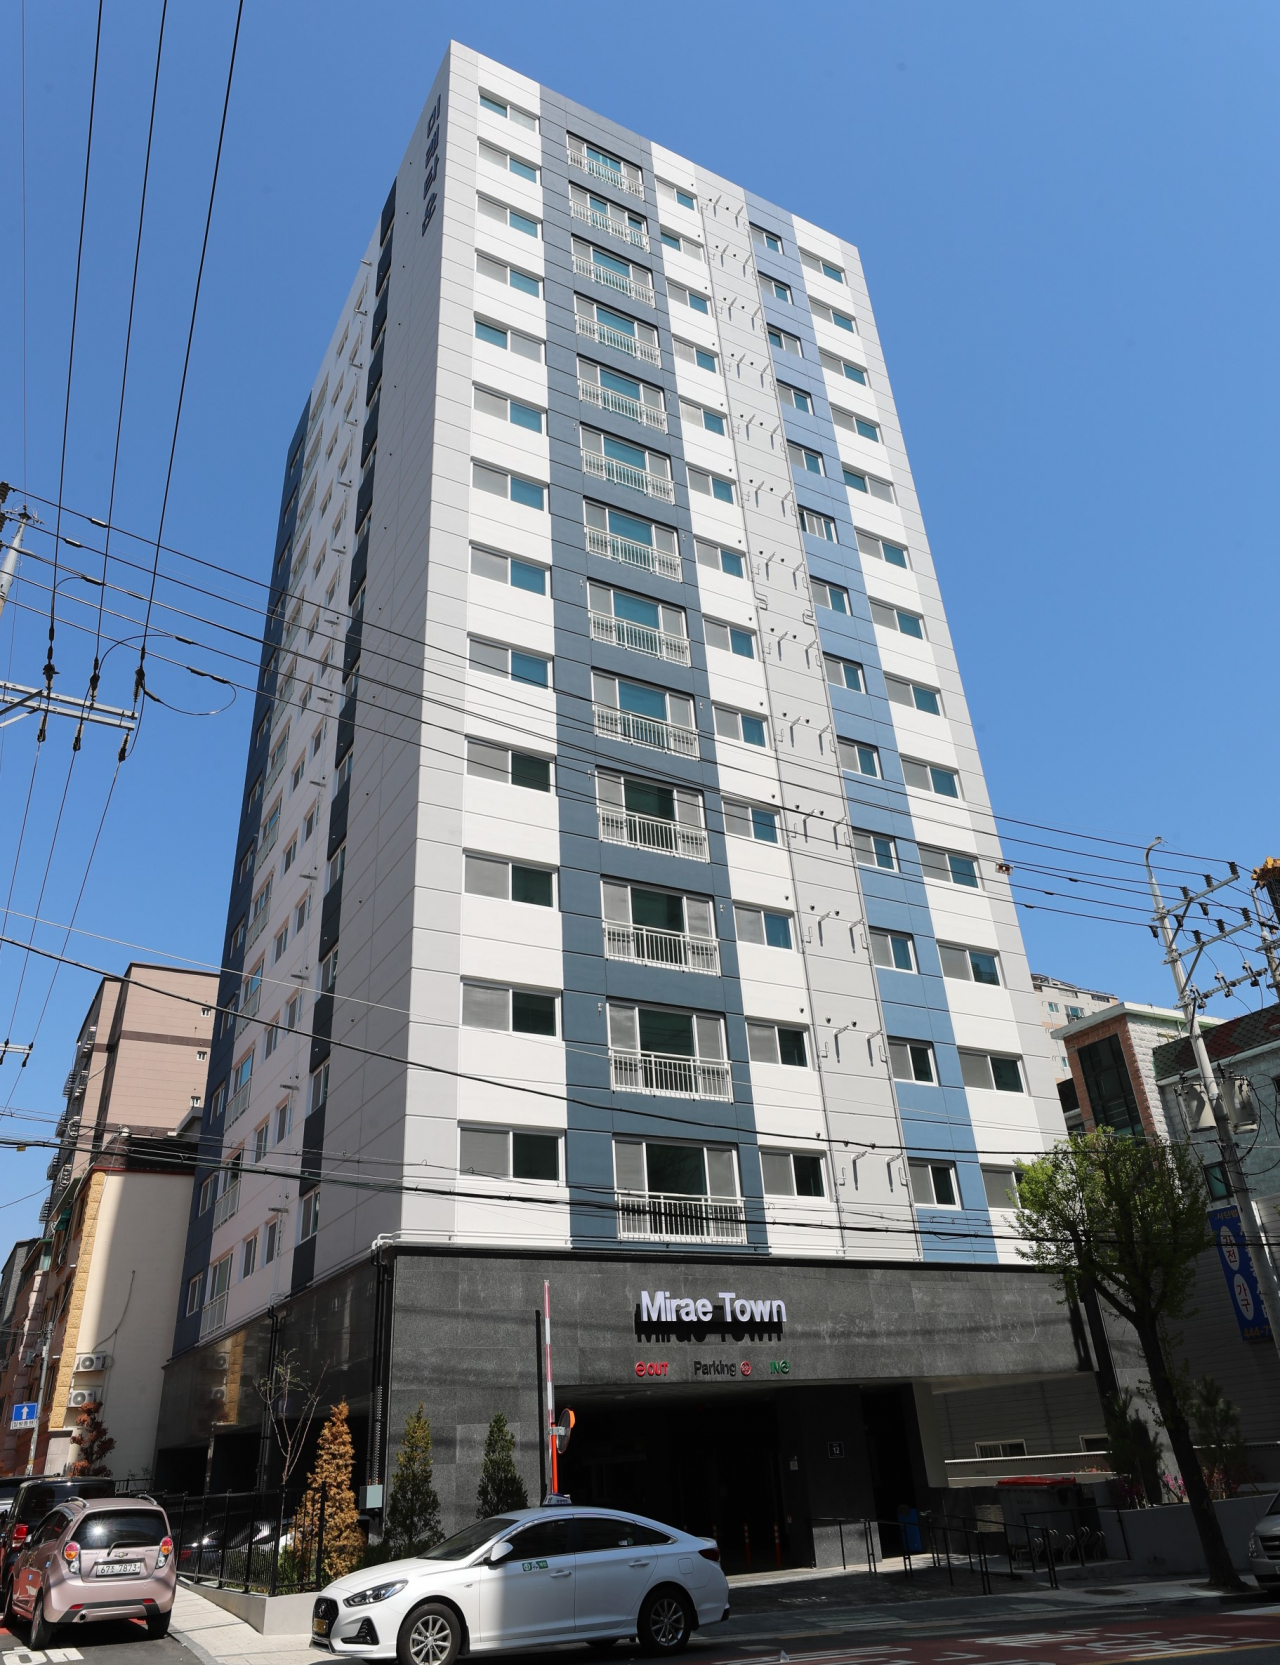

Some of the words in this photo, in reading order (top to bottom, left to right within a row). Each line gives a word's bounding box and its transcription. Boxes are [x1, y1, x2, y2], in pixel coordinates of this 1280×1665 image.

[422, 94, 441, 237] 미래타운
[1217, 1209, 1239, 1220] 사단법
[1222, 1235, 1238, 1263] 가전
[1236, 1283, 1251, 1312] 가구
[641, 1290, 714, 1322] Mirae
[718, 1292, 787, 1322] Town
[647, 1361, 668, 1376] OUT
[694, 1360, 737, 1376] Parking
[769, 1360, 780, 1374] IN
[832, 1446, 840, 1454] 12
[118, 1564, 137, 1573] 7873
